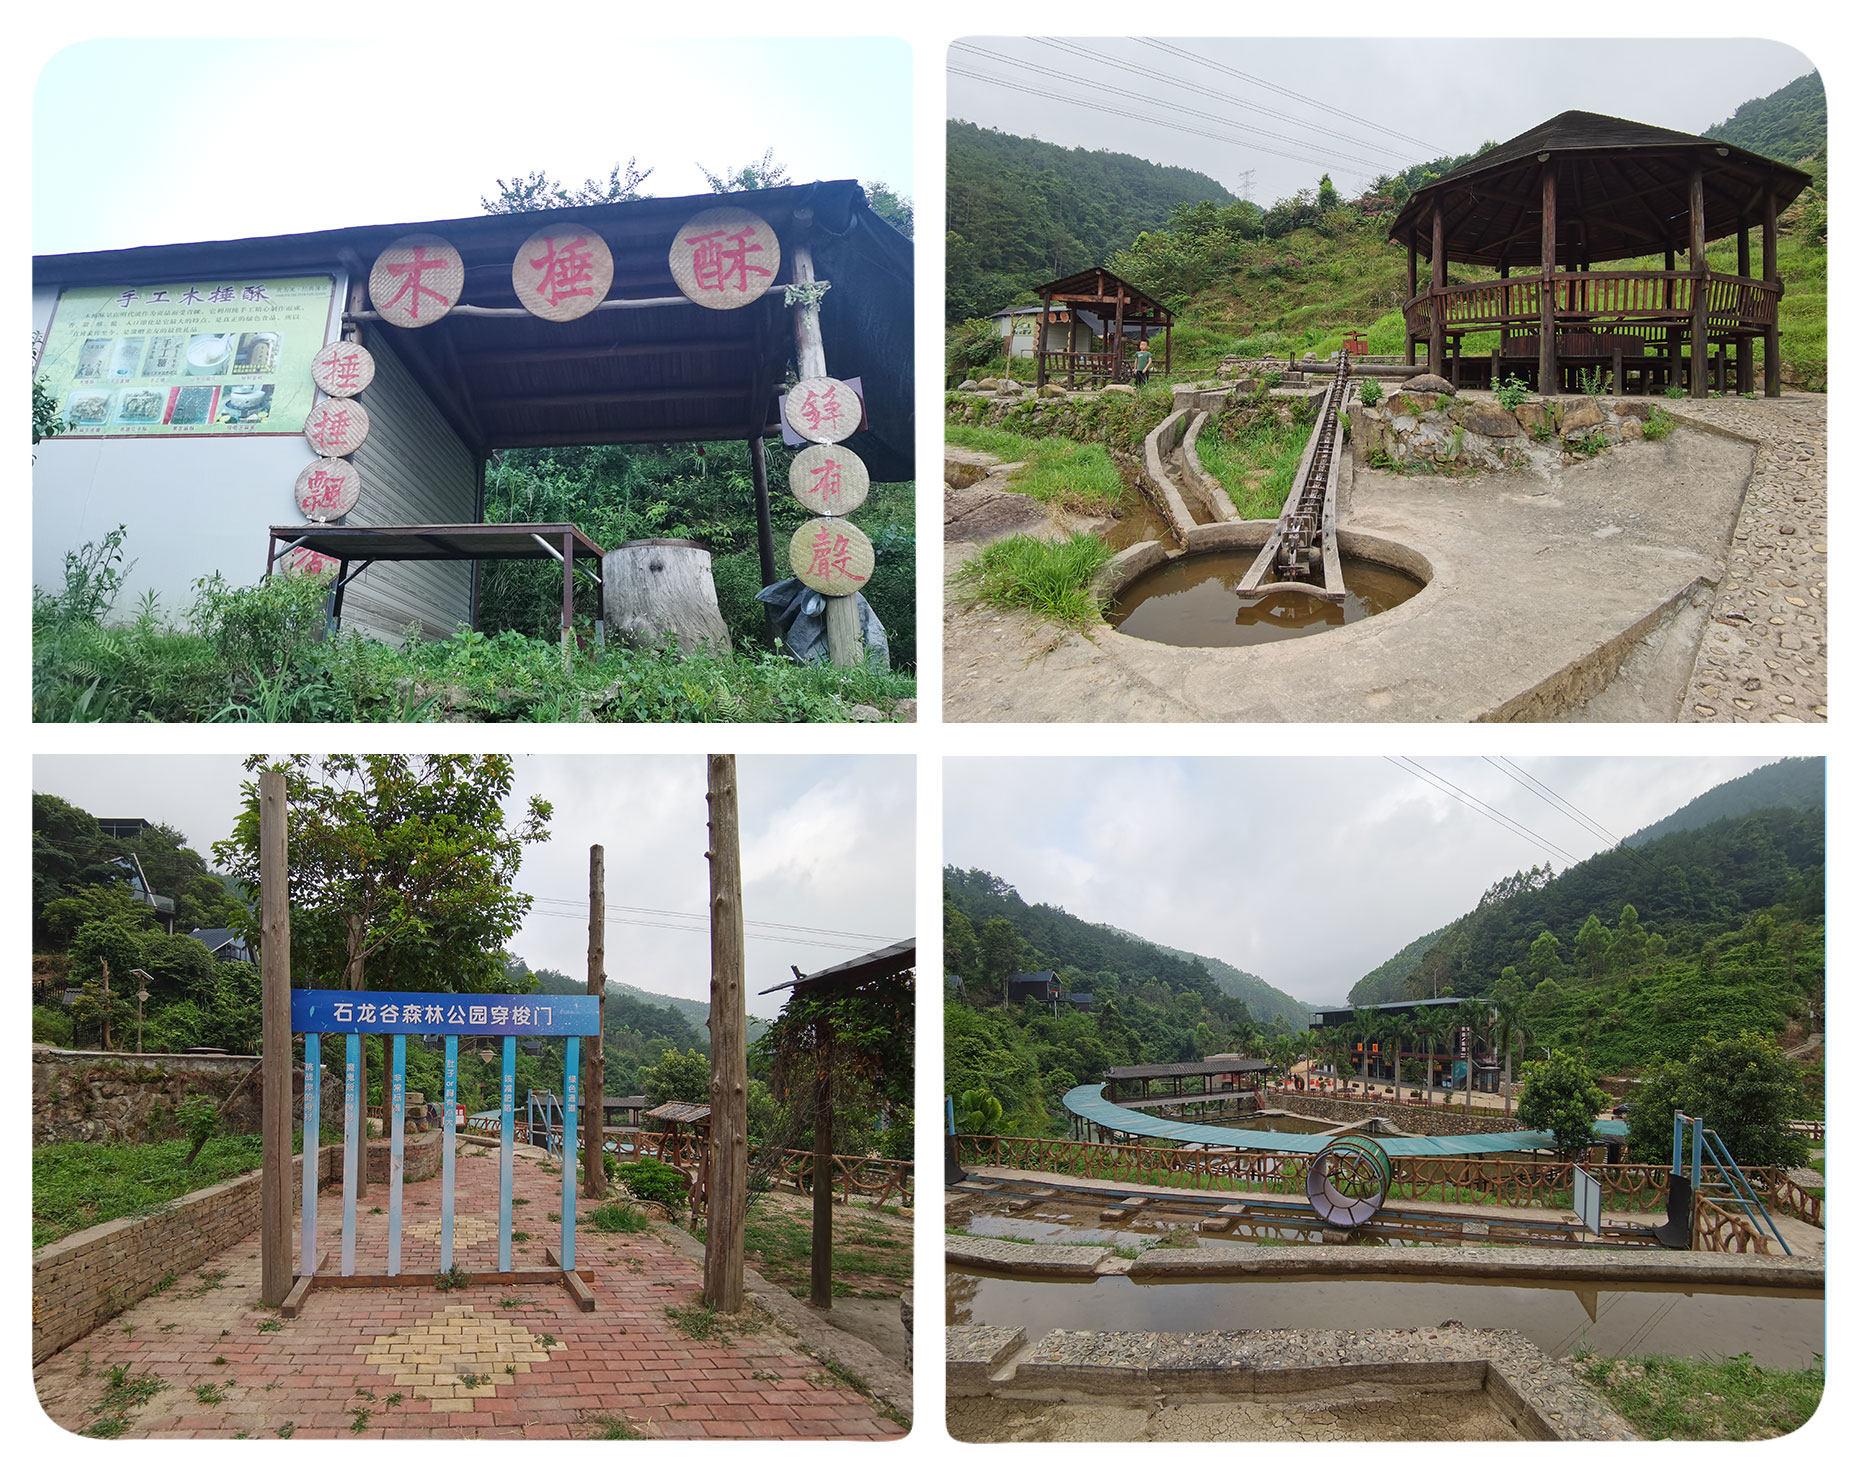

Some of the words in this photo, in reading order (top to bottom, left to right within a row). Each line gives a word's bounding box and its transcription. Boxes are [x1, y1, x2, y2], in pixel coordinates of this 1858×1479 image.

[381, 226, 772, 319] 木捶酥
[115, 284, 271, 309] 手工木捶酥
[333, 1002, 553, 1026] 石龙谷森林公园穿梭门
[568, 1075, 577, 1113] 绿色通道
